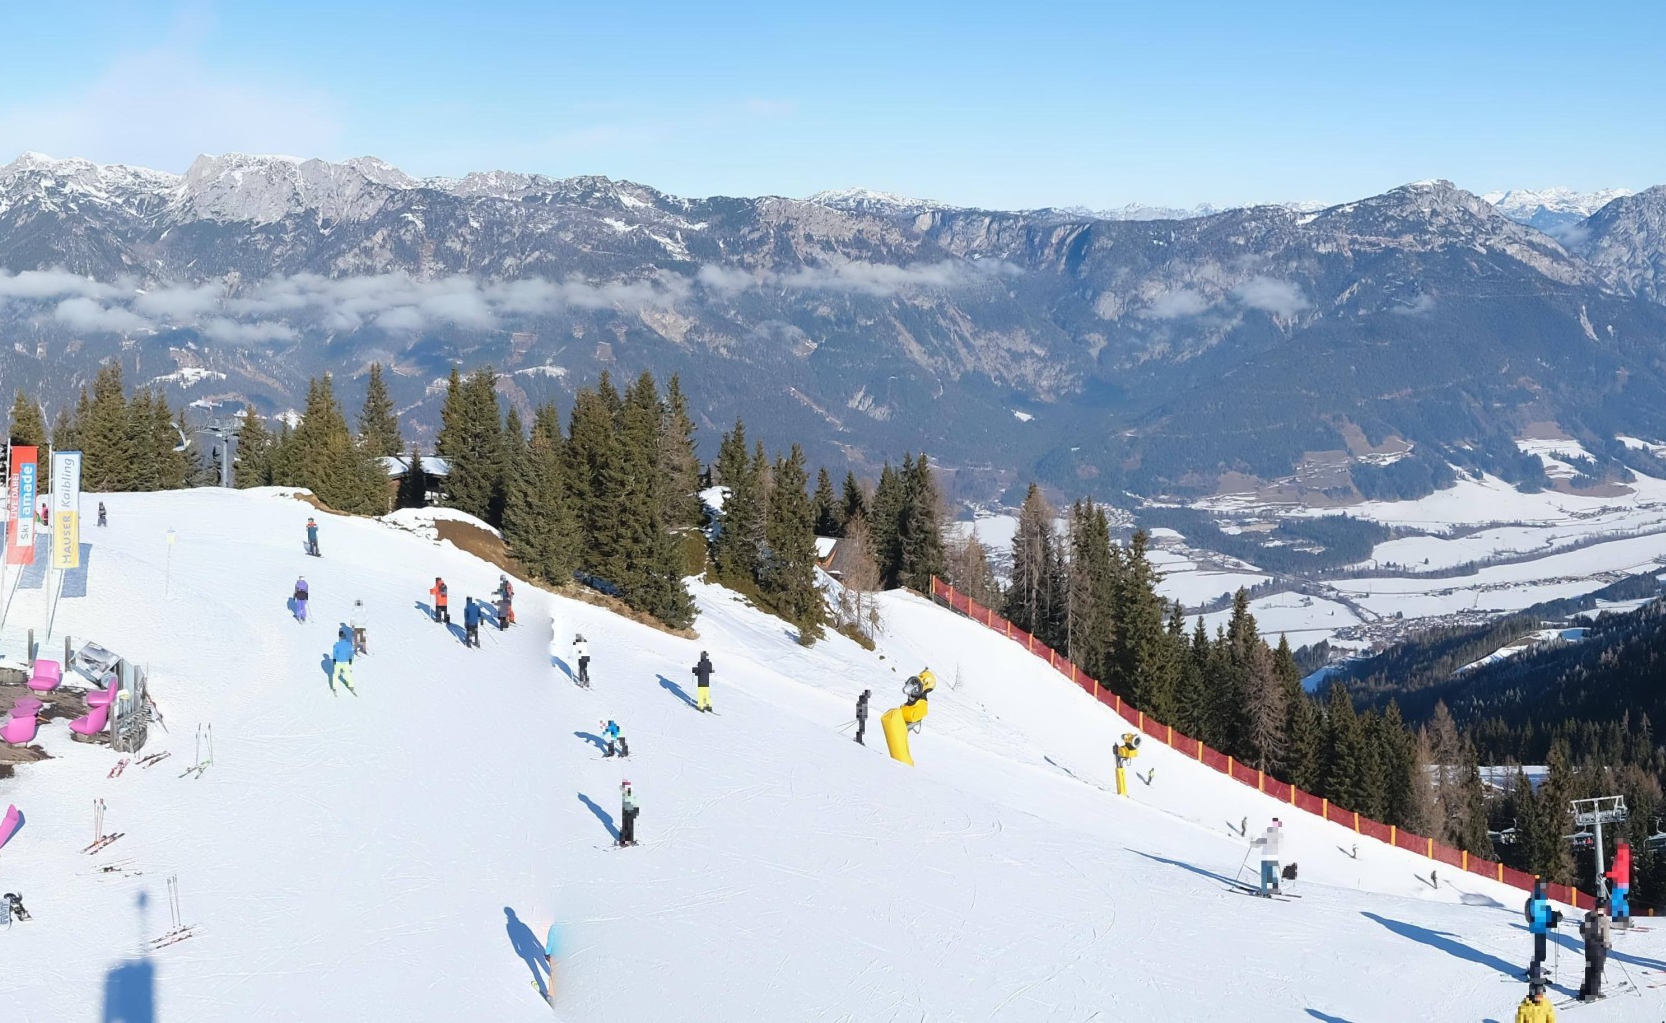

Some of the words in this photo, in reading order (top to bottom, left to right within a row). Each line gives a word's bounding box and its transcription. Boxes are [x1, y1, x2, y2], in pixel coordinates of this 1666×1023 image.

[61, 458, 75, 508] Kaibling
[21, 524, 30, 540] Ski
[62, 515, 72, 564] HAUSER
